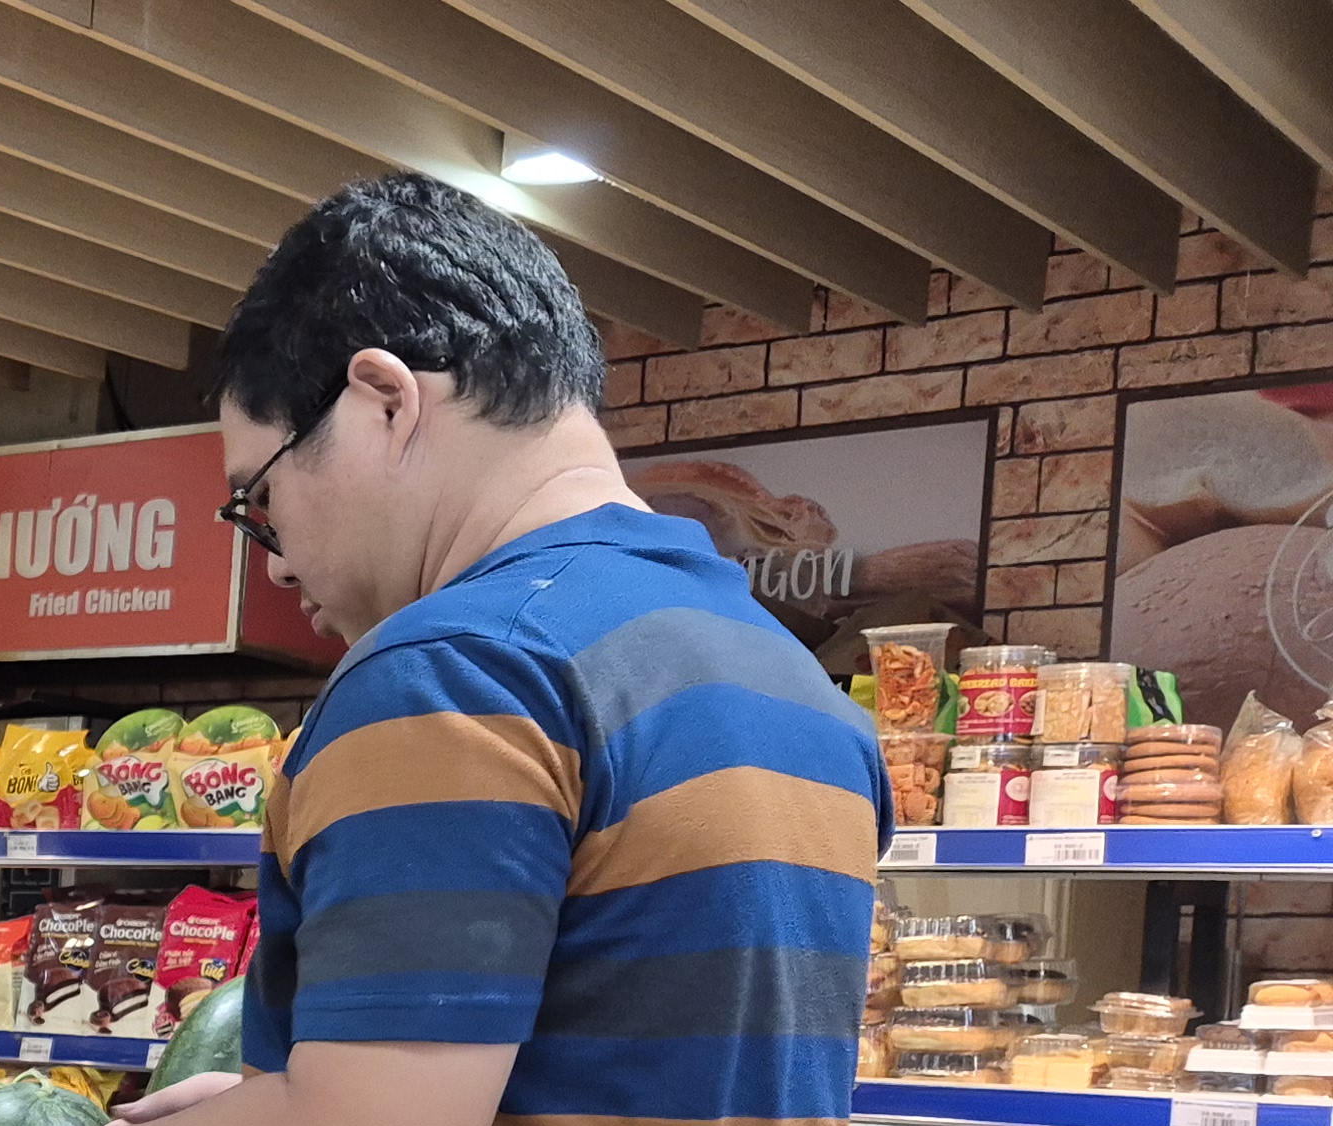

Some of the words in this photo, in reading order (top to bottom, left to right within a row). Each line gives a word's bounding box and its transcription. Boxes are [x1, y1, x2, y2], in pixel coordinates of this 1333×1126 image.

[29, 590, 79, 618] Fried
[85, 587, 171, 615] Chicken
[118, 781, 152, 797] BANG
[204, 786, 247, 807] BANG
[169, 920, 236, 942] ChocoPie
